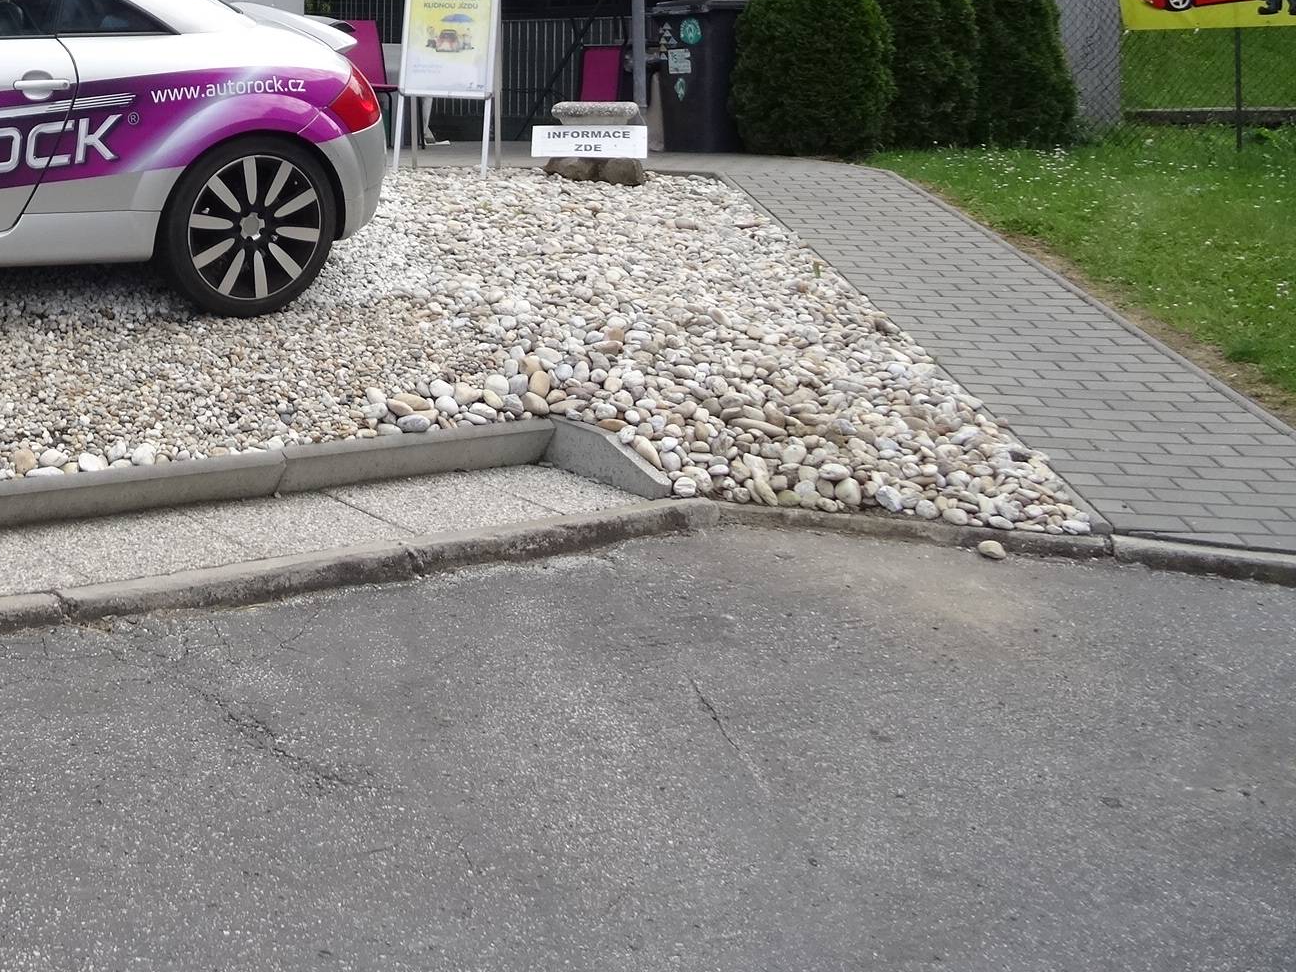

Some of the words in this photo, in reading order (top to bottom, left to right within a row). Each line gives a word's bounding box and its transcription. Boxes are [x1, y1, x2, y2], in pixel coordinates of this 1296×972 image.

[150, 75, 307, 104] www.autorock.cz
[547, 130, 631, 139] INFORMACE
[574, 143, 602, 152] ZDE
